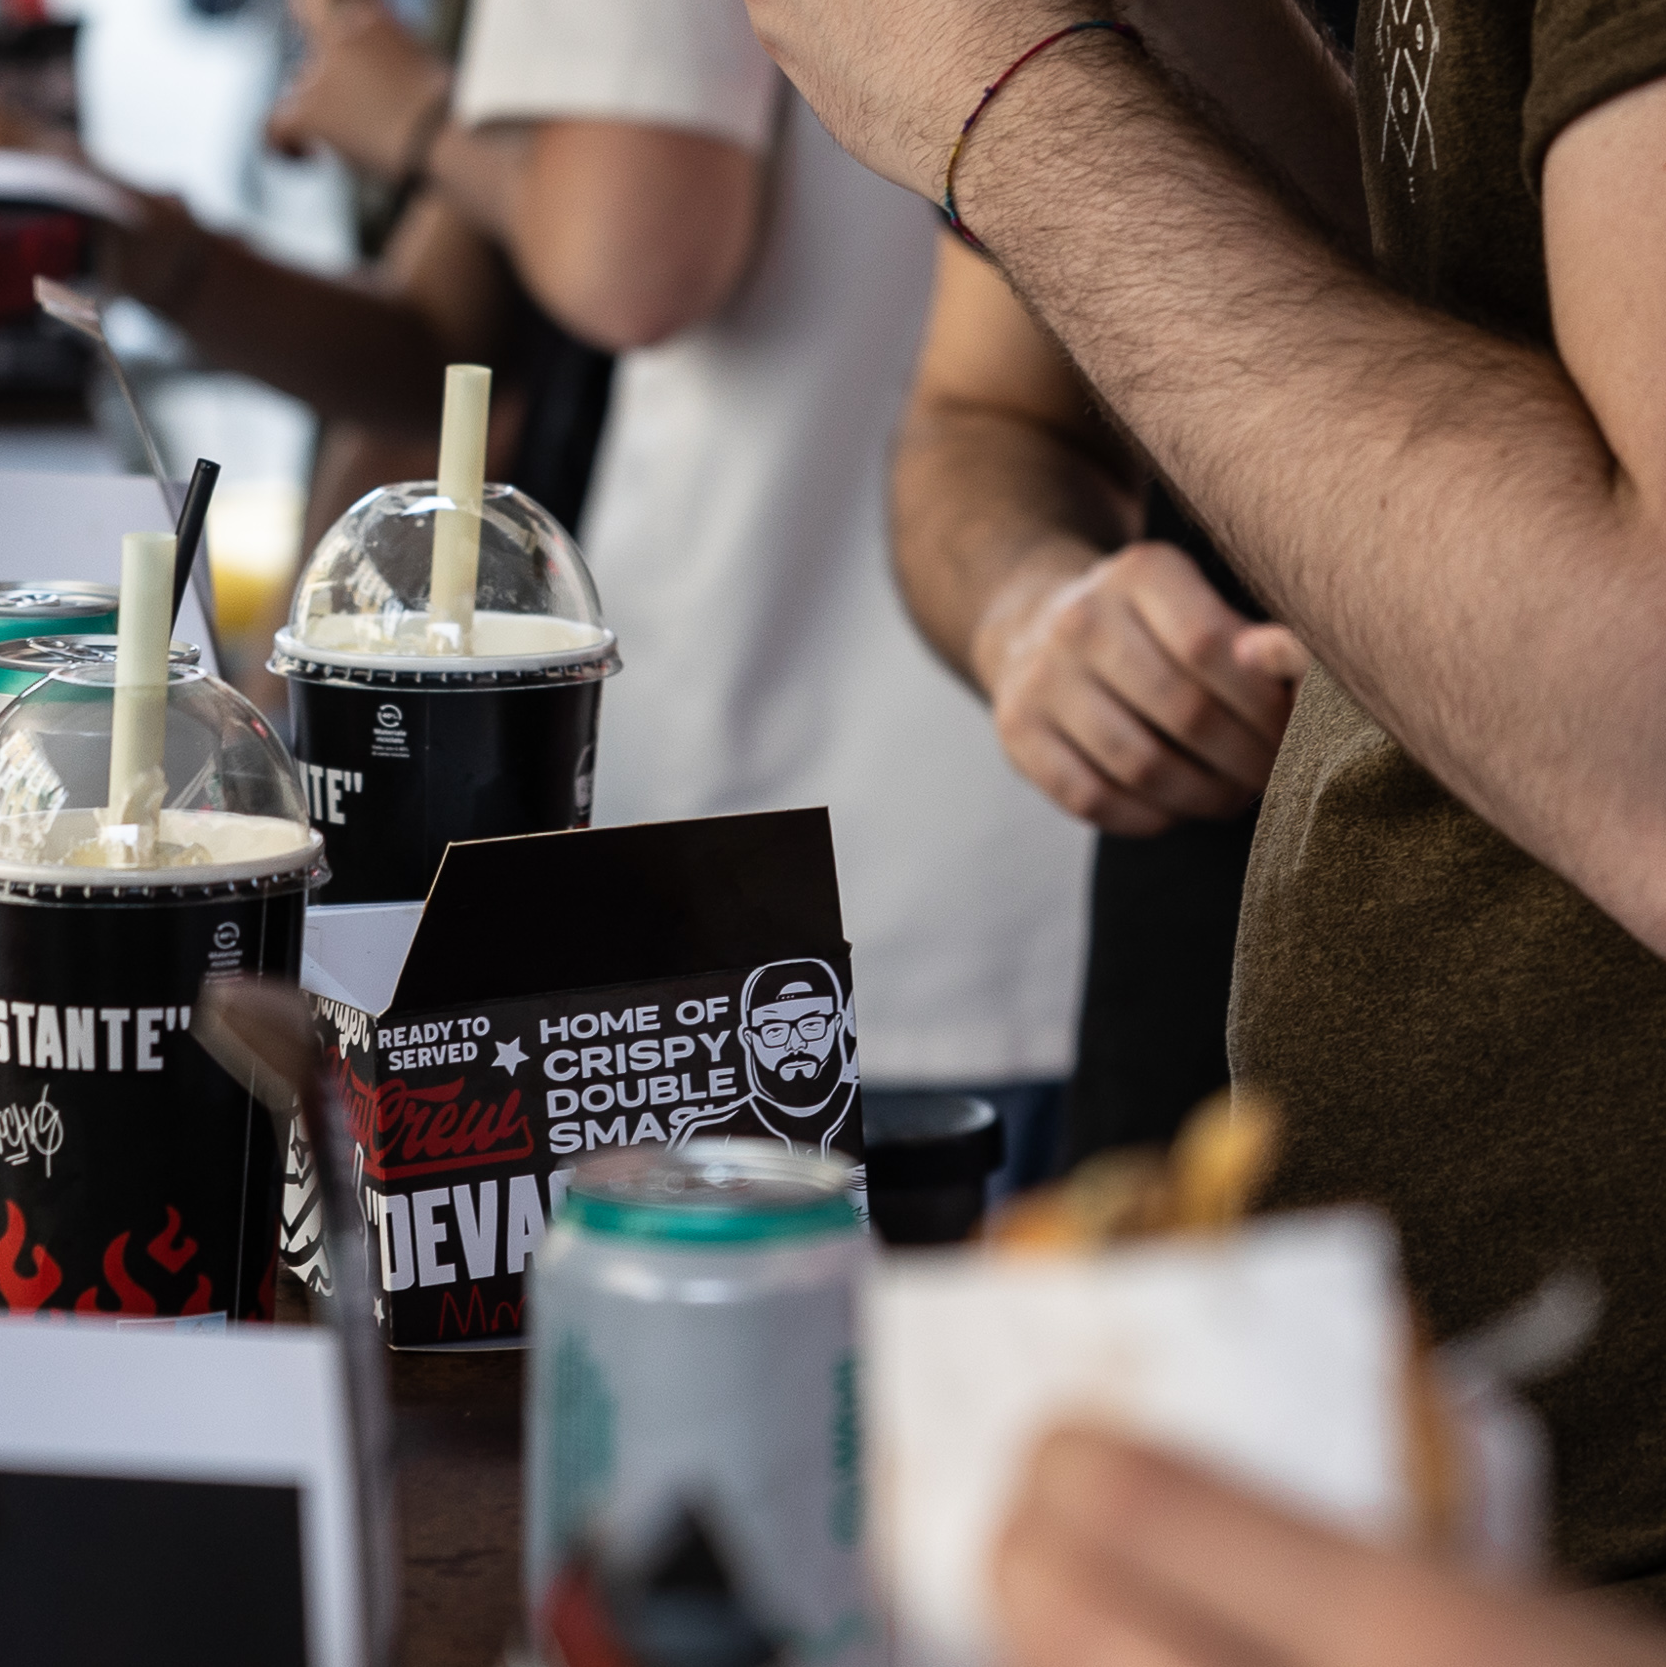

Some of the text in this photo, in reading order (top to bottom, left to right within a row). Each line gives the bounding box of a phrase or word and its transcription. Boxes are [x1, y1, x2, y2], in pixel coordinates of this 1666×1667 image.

[378, 1016, 491, 1050] READY TO
[539, 995, 730, 1044] HOME OF
[388, 1041, 479, 1071] SERVED
[543, 1030, 732, 1082] CRISPY
[546, 1067, 738, 1119] DOUBLE
